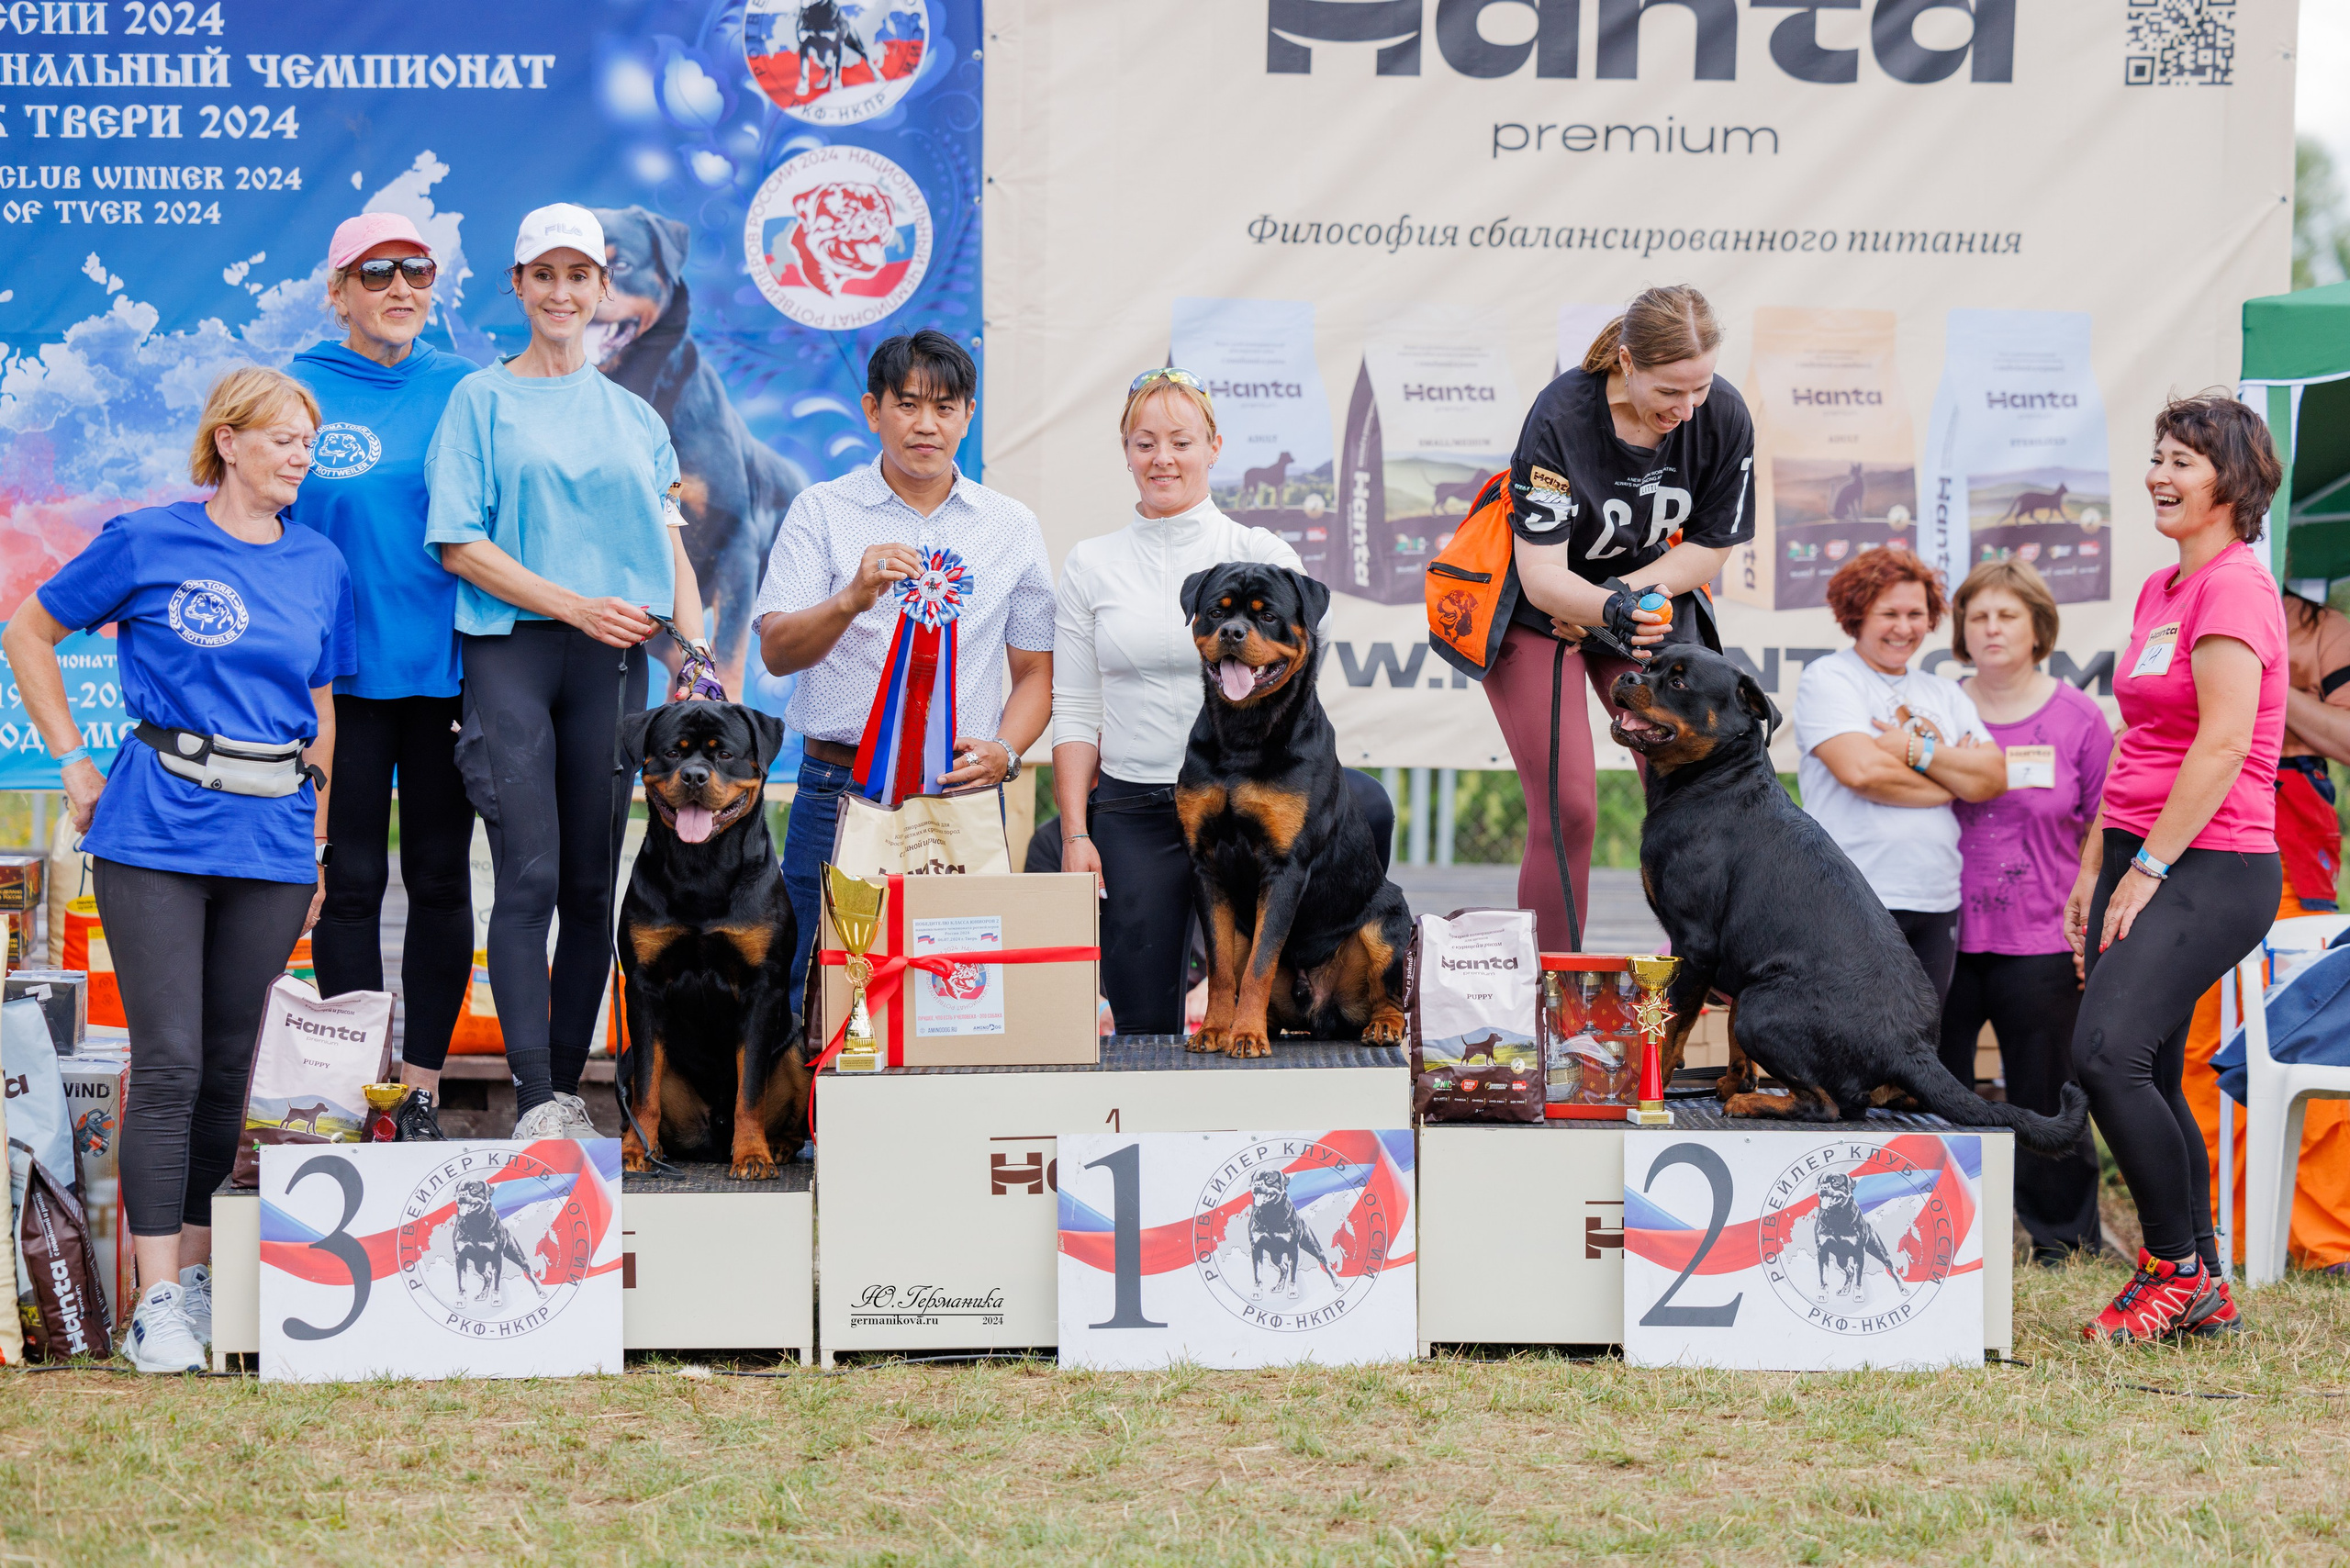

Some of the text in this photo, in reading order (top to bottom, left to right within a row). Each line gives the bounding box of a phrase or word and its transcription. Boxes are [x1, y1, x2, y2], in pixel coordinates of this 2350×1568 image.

[0, 1, 224, 35] СИИ 2024
[249, 54, 555, 88] ЧЕМПИОНАТ
[25, 105, 183, 139] ТВЕРИ
[199, 106, 299, 139] 2024
[1493, 116, 1779, 159] premium
[800, 149, 839, 169] 2024
[0, 165, 301, 190] CLUB WINNER 2024
[3, 200, 221, 225] OF TVER 2024
[544, 223, 583, 237] FILA
[1248, 214, 2023, 258] Философия сбалансированного питания
[1209, 379, 1302, 398] Hanta
[1404, 383, 1495, 401] Hanta
[1792, 387, 1883, 405] Hanta
[1986, 390, 2078, 409] Hanta
[316, 462, 369, 476] ROTTWEILER
[1355, 471, 1371, 588] Hanta
[207, 582, 236, 601] TORRA
[182, 629, 238, 644] ROTTWEILER
[285, 1013, 366, 1043] Hanta
[306, 1036, 339, 1047] premium
[303, 1058, 330, 1069] PUPPY
[400, 1153, 589, 1290] РОТВЕЙЛЕР КЛУБ РОССИИ
[1195, 1142, 1385, 1282] РОТВЕЙЛЕР КЛУБ РОССИИ
[1762, 1146, 1951, 1284] РОТВЕЙЛЕР КЛУБ РОССИИ
[283, 1154, 372, 1340] 3
[1084, 1143, 1168, 1329] 1
[1639, 1142, 1744, 1327] 2
[50, 1258, 89, 1355] Hanta
[446, 1306, 550, 1337] РКФ-НКПР
[1242, 1298, 1347, 1328] РКФ-НКПР
[1807, 1304, 1912, 1333] РКФ-НКПР
